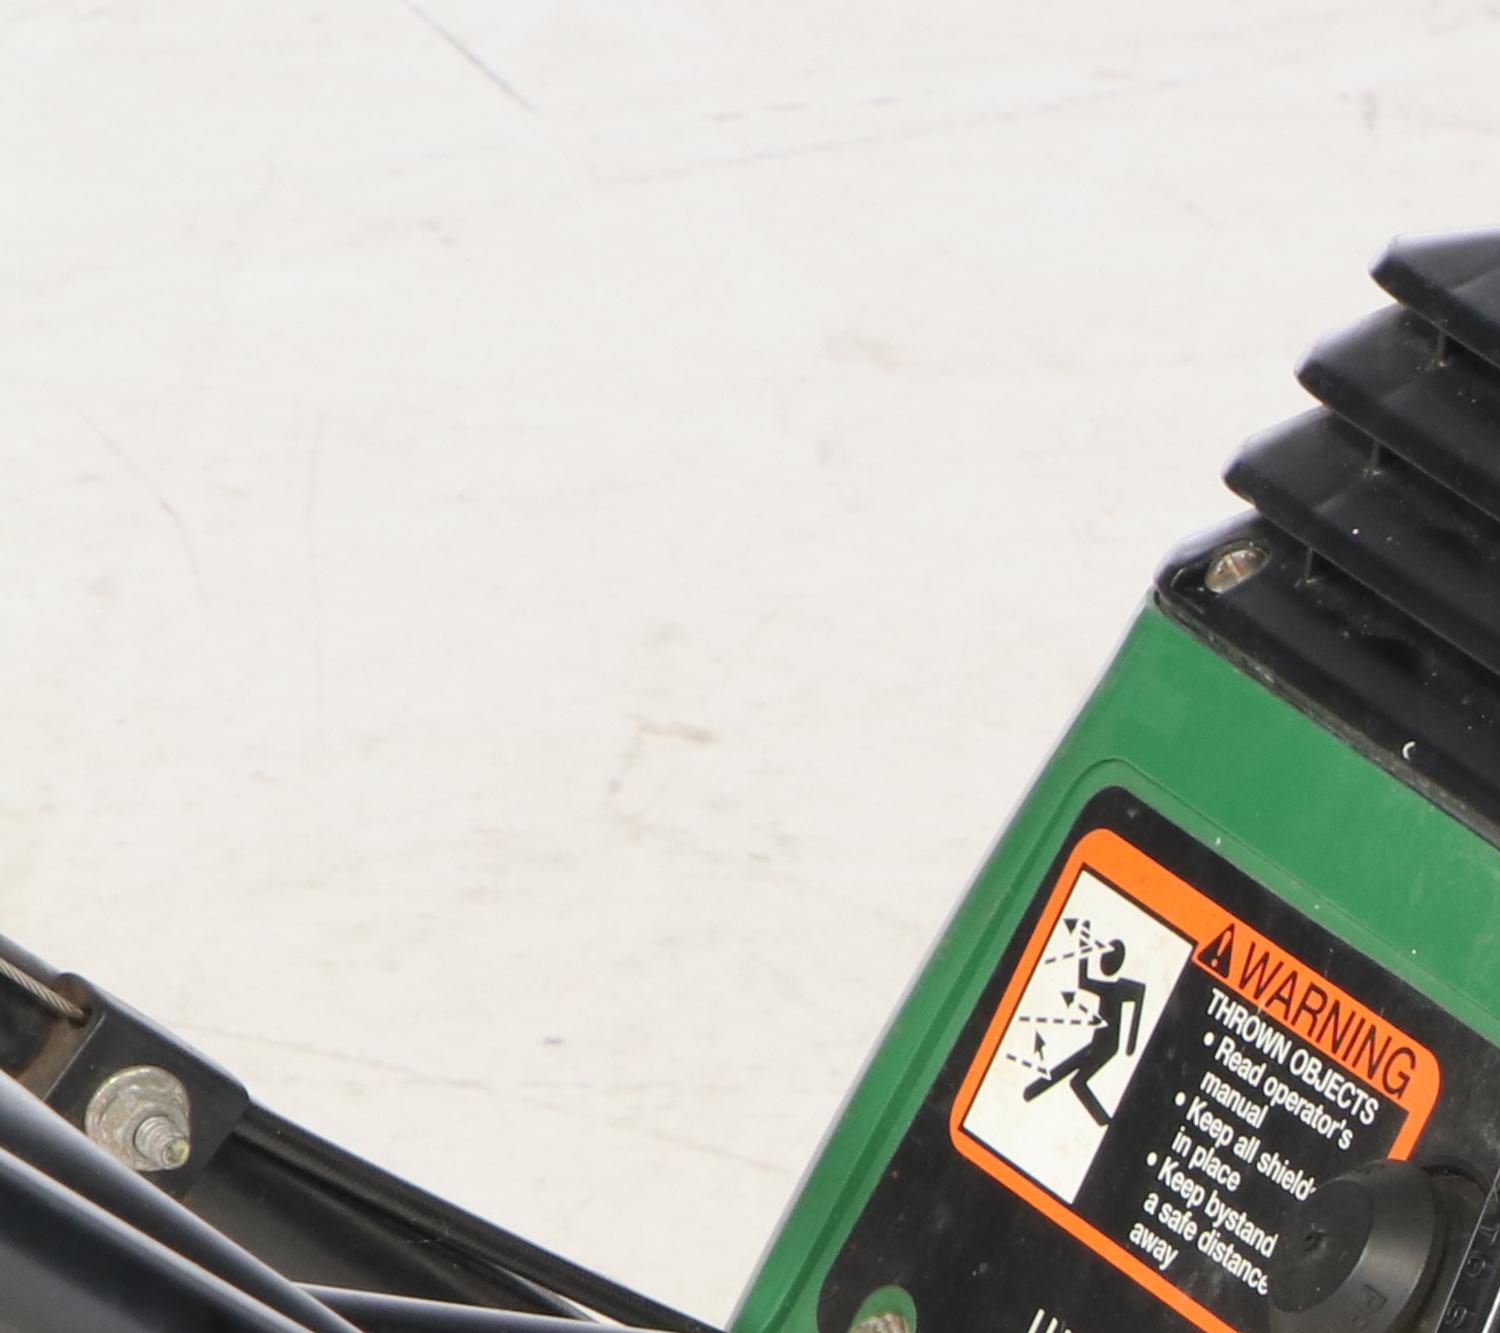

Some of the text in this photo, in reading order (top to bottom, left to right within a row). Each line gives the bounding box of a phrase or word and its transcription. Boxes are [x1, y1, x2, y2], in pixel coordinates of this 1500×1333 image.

[1238, 941, 1416, 1100] WARNING
[1206, 988, 1379, 1126] THROWN OBJECTS
[1200, 1070, 1269, 1129] manual
[1215, 1036, 1354, 1151] Read operator's
[1172, 1126, 1241, 1193] in place
[1186, 1096, 1235, 1150] Keep
[1236, 1130, 1260, 1165] all
[1143, 1192, 1159, 1216] a
[1158, 1203, 1198, 1241] safe
[1157, 1155, 1279, 1258] Keep bystand
[1129, 1222, 1179, 1271] away
